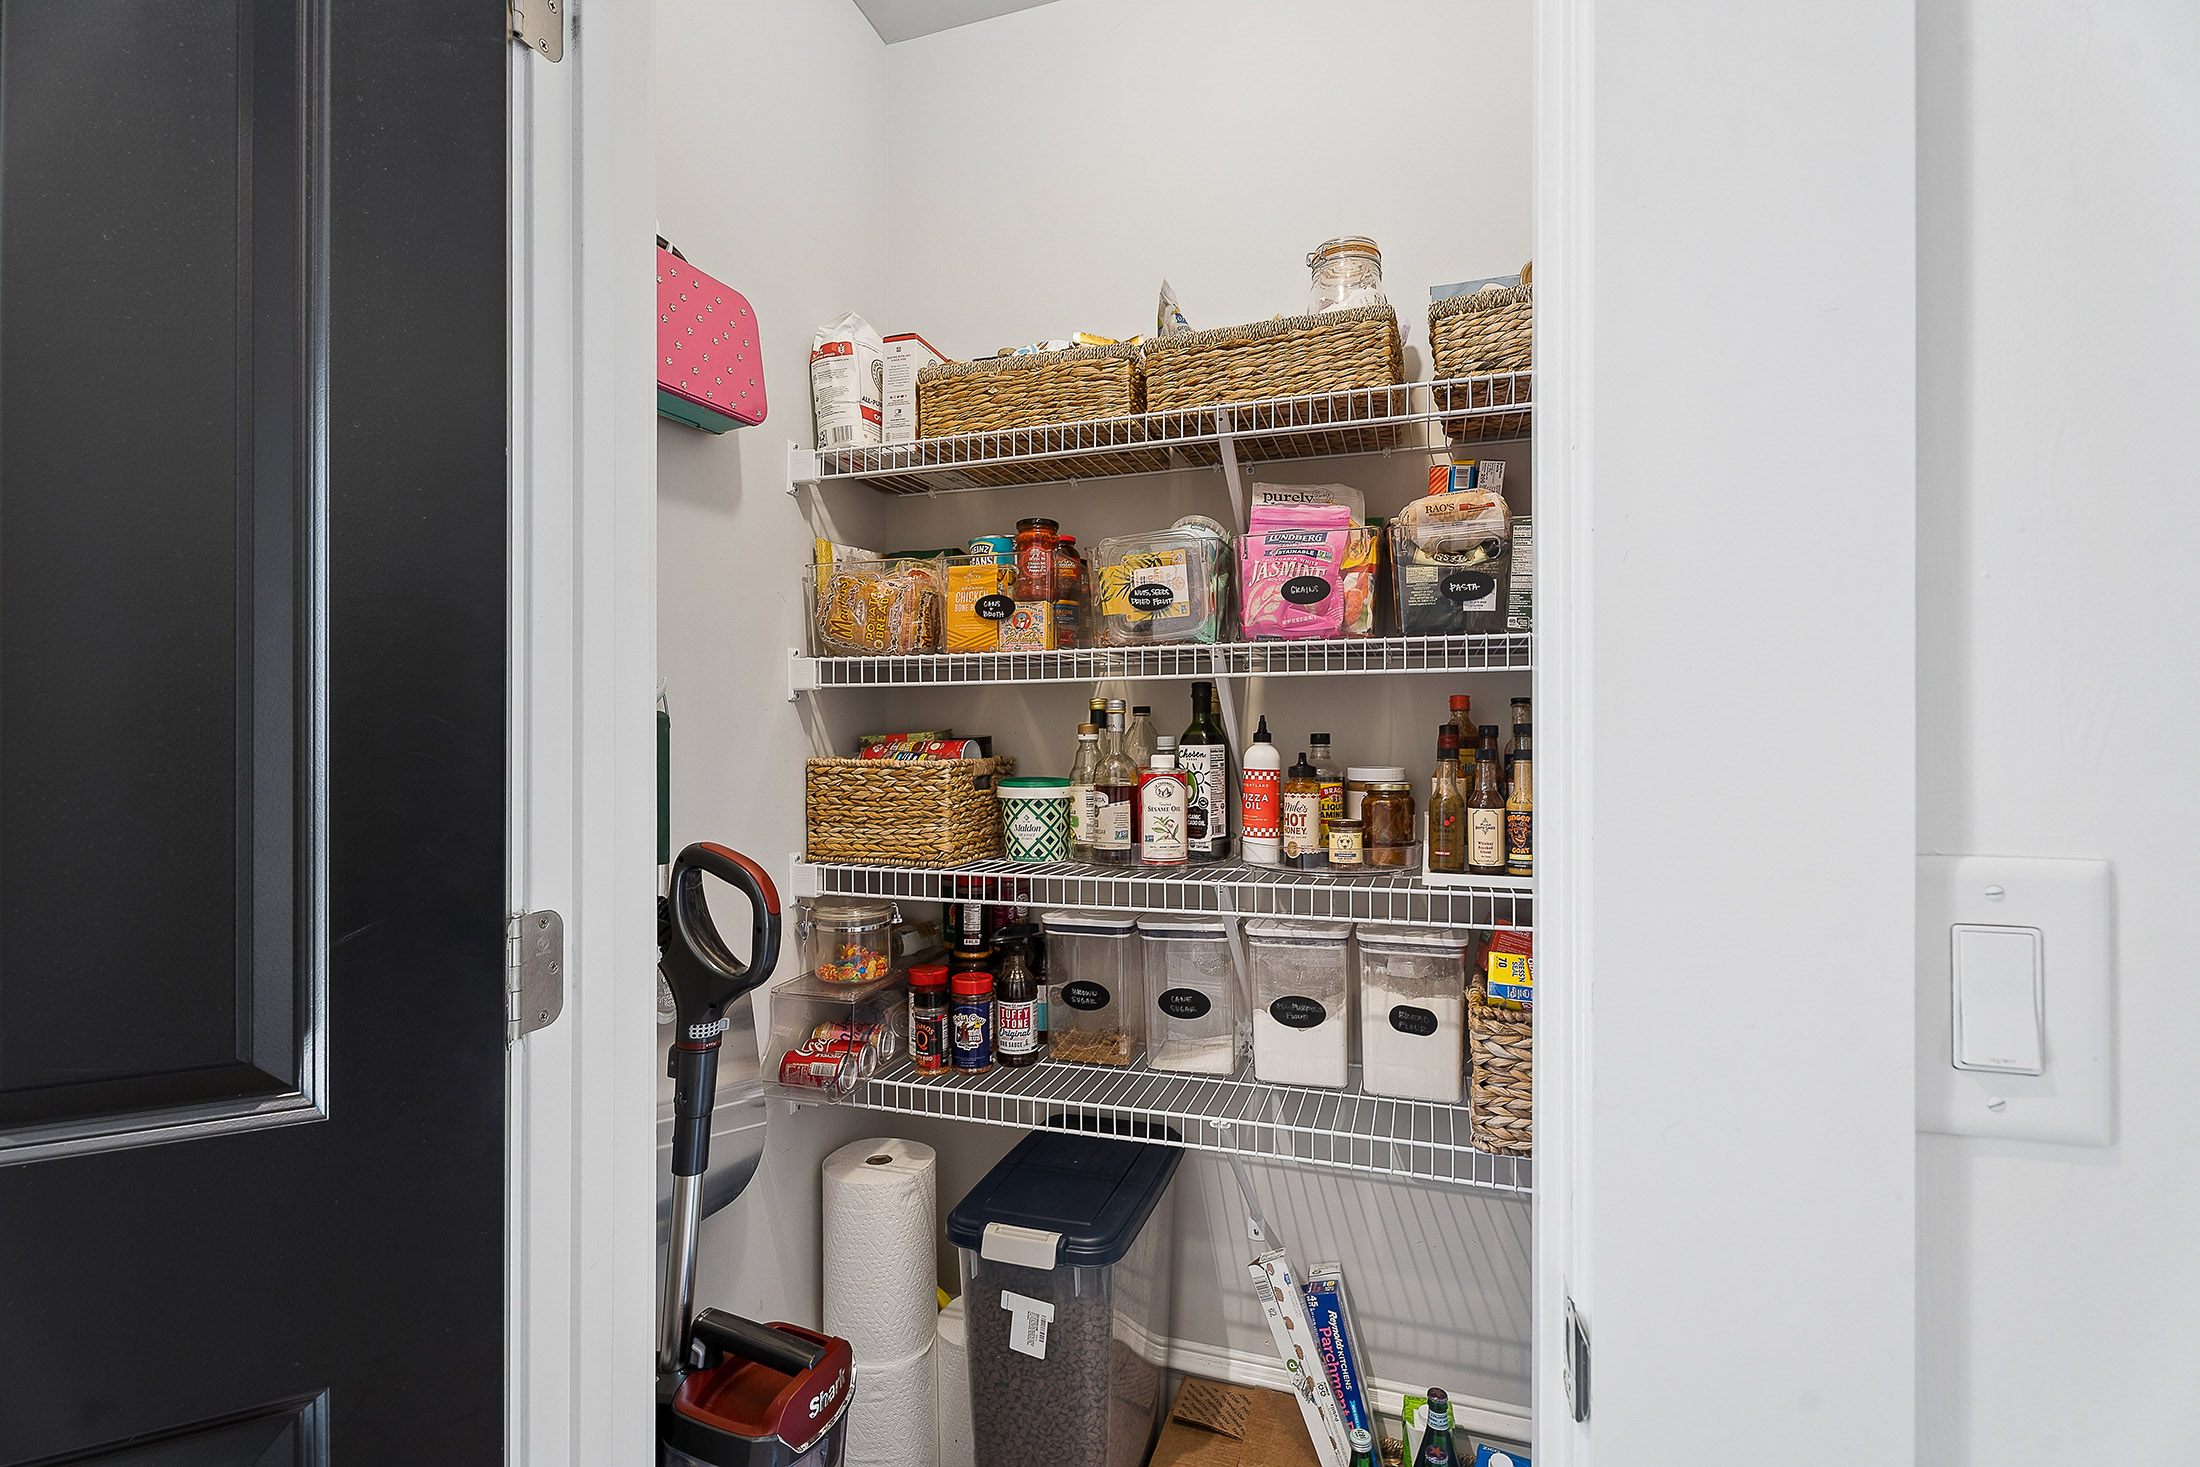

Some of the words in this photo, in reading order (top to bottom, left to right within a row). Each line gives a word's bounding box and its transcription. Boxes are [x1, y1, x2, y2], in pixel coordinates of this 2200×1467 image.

[1263, 492, 1314, 504] purely
[1425, 503, 1455, 514] RAO'S
[1290, 585, 1319, 594] GRAINS
[1449, 582, 1480, 592] PASTA
[954, 603, 969, 612] BONE
[983, 600, 1001, 608] CANS
[876, 597, 890, 639] BREAD
[982, 610, 1005, 618] BROTH
[1242, 794, 1268, 802] PIZZA
[1245, 801, 1261, 810] OIL
[1284, 813, 1307, 826] HOT
[1013, 824, 1042, 832] Maldon
[1498, 957, 1507, 968] 70
[1170, 995, 1192, 1003] CANE
[1000, 1008, 1029, 1018] TUFFY
[1169, 1005, 1197, 1013] SUGAR
[1000, 1019, 1029, 1028] STONE
[999, 1028, 1031, 1040] Original
[1328, 1309, 1345, 1351] Reynolds
[1337, 1350, 1352, 1391] KITCHENS
[1319, 1326, 1350, 1417] Parchment
[808, 1367, 846, 1419] Shark
